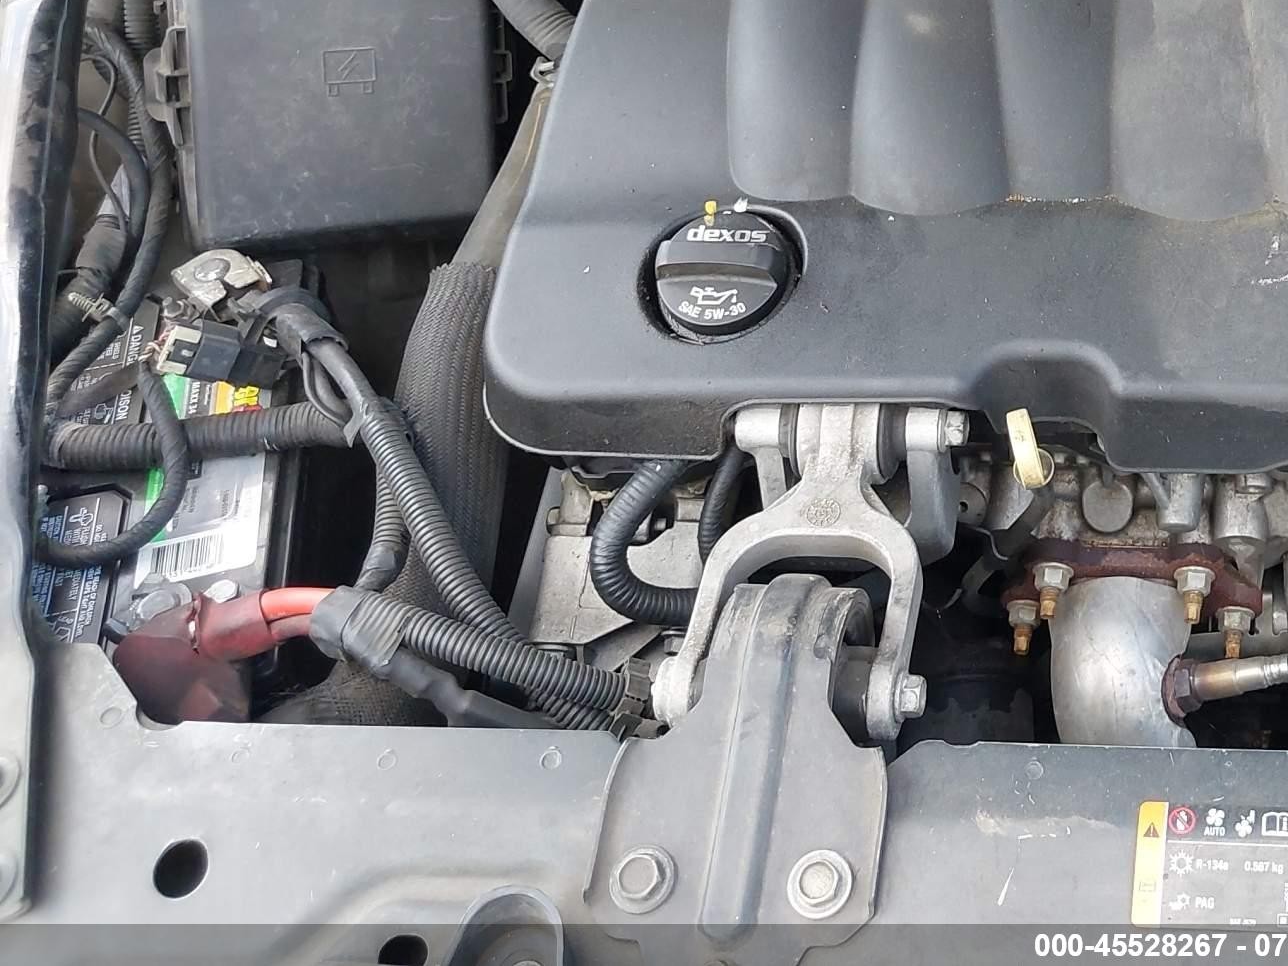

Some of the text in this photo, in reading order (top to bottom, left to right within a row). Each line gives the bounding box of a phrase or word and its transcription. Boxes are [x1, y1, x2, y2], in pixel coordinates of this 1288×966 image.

[687, 225, 769, 242] dexos
[678, 301, 746, 320] SAE 5W-30
[126, 334, 142, 365] DANG
[116, 390, 132, 420] OISON
[1203, 826, 1226, 837] AUTO
[1272, 862, 1284, 875] kg
[1195, 896, 1215, 909] PAG
